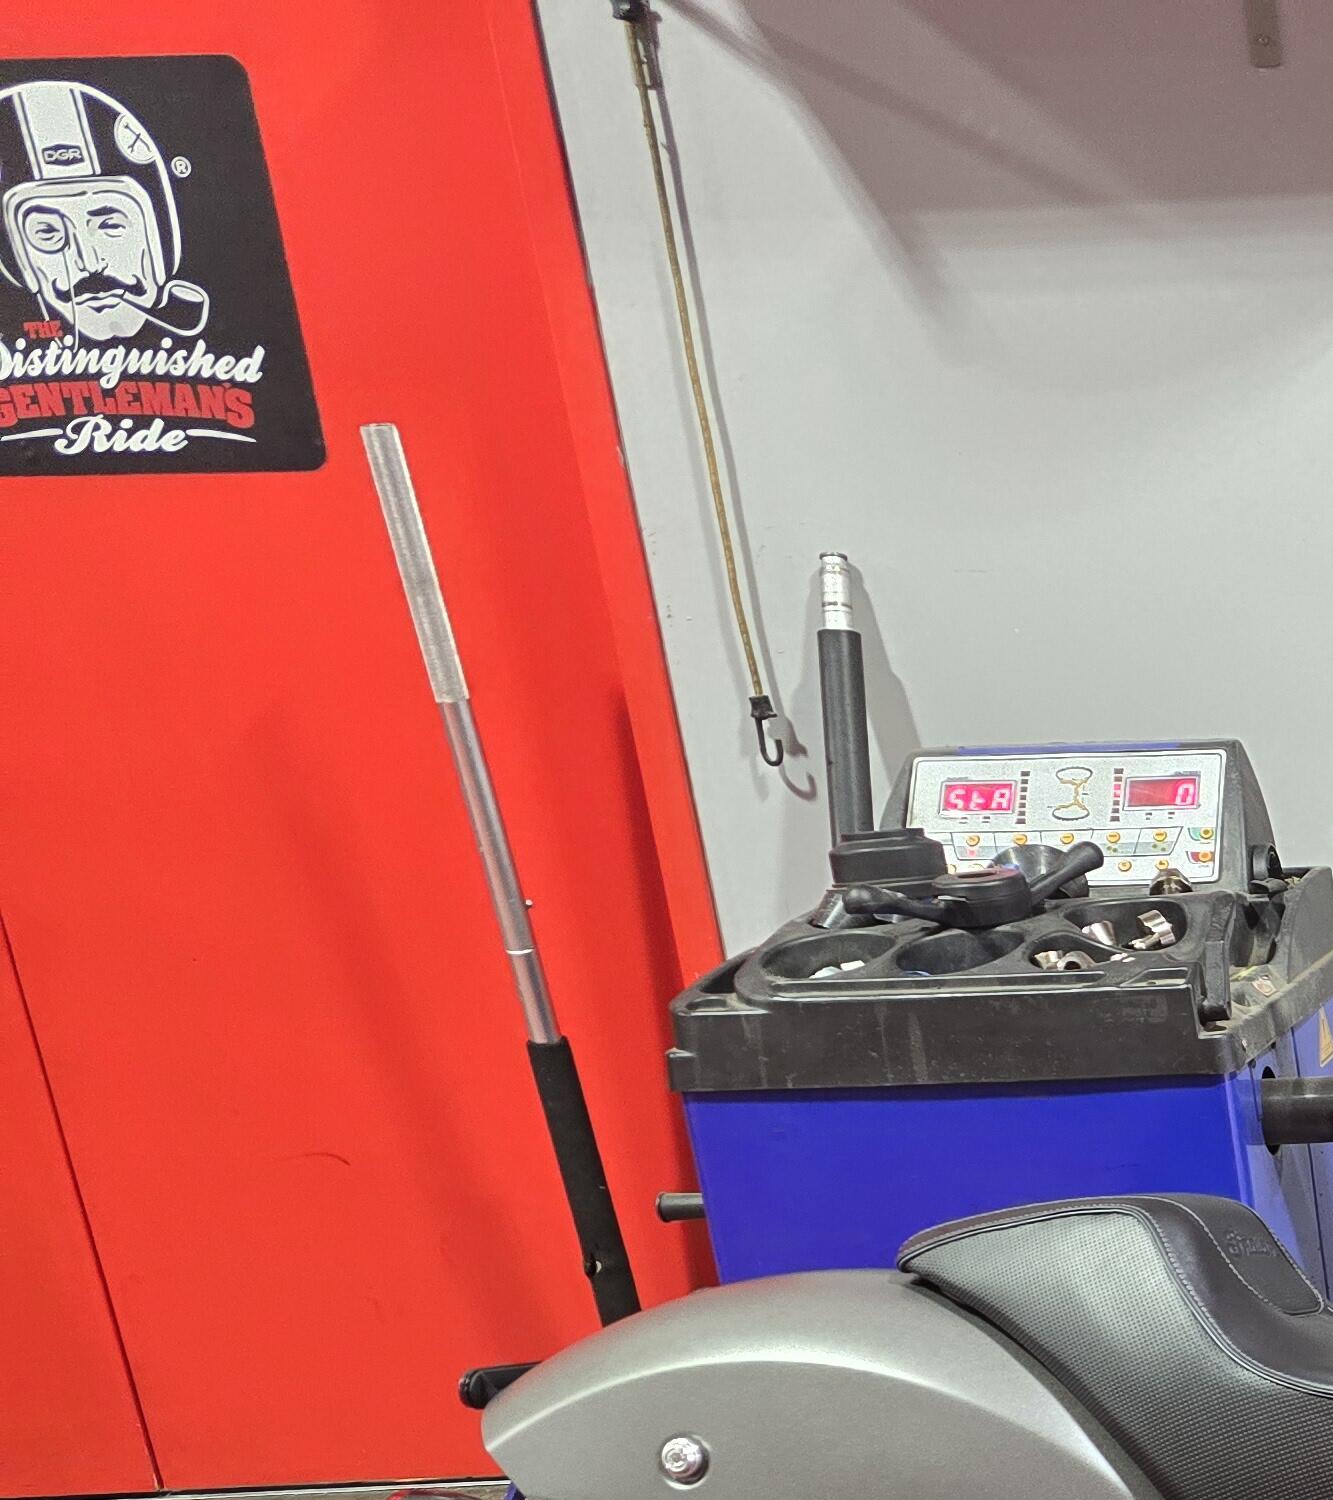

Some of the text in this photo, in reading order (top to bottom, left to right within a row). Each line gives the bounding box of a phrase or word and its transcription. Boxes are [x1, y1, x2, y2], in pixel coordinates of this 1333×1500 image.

[44, 148, 82, 161] DGR
[23, 320, 63, 339] THE
[54, 414, 189, 454] Ride
